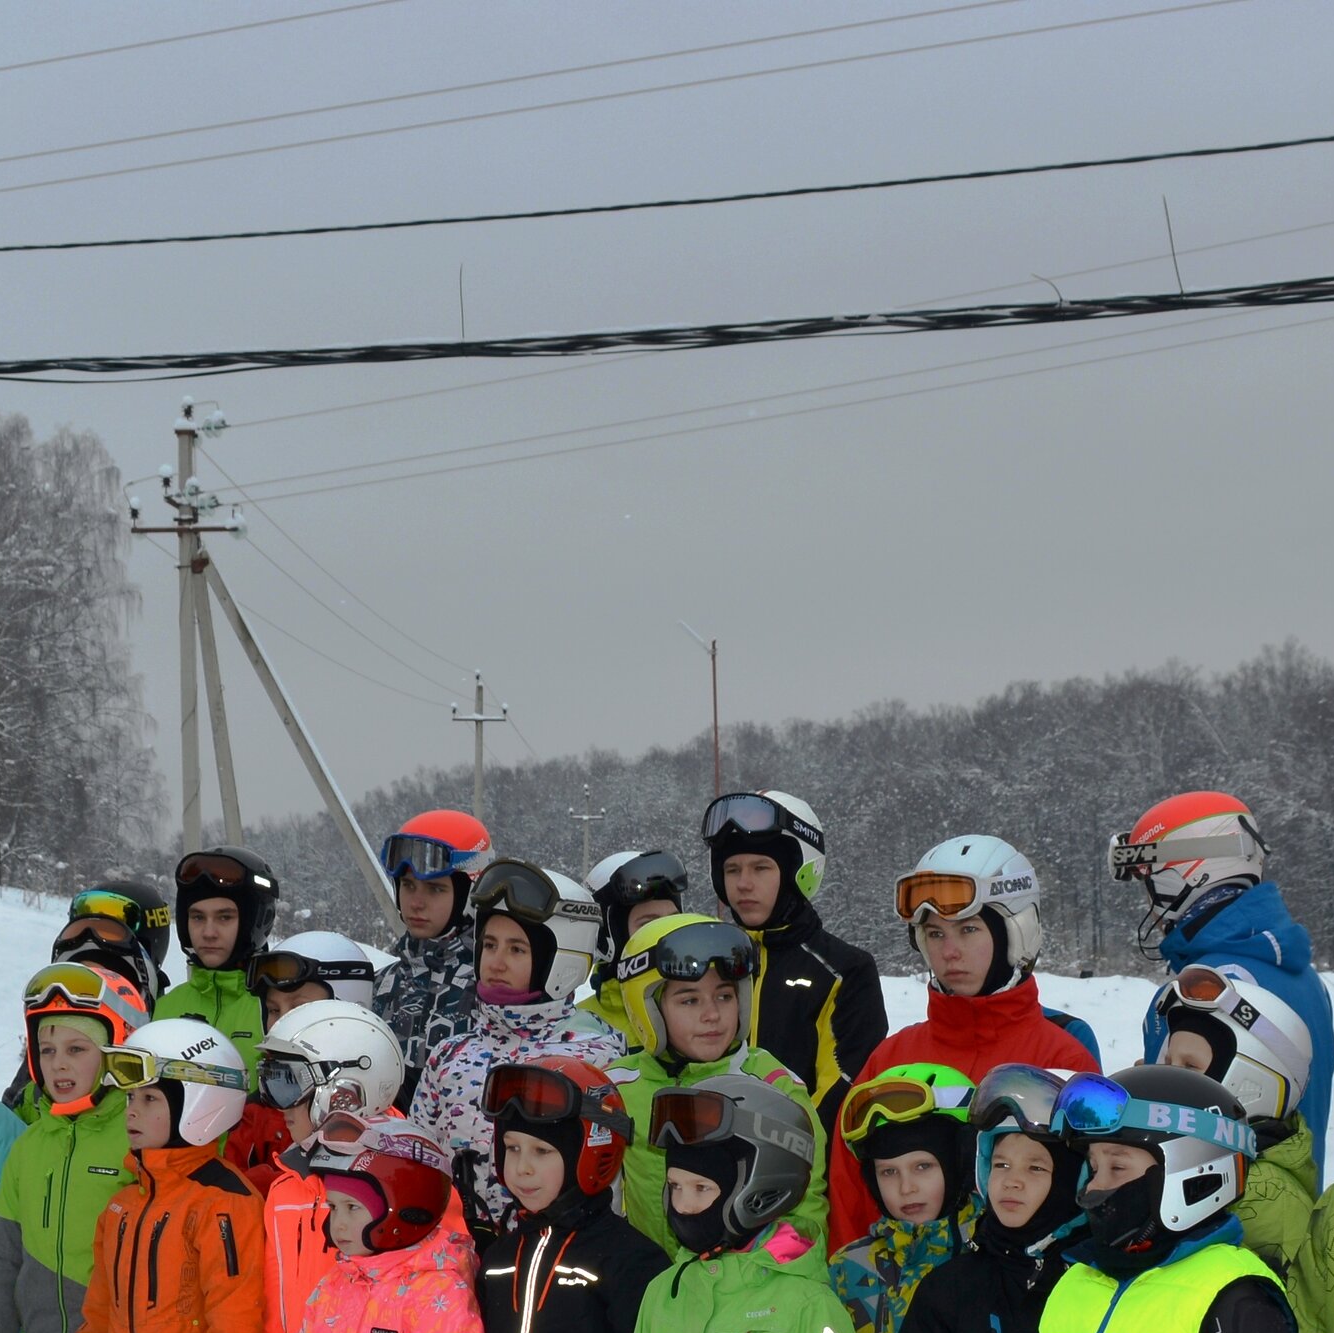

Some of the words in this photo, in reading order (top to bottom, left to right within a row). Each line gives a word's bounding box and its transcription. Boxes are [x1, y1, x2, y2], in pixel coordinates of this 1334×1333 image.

[793, 820, 819, 844] SMITH
[989, 876, 1032, 896] ATOMIC
[181, 1037, 218, 1061] uvex
[1148, 1103, 1196, 1133] BE
